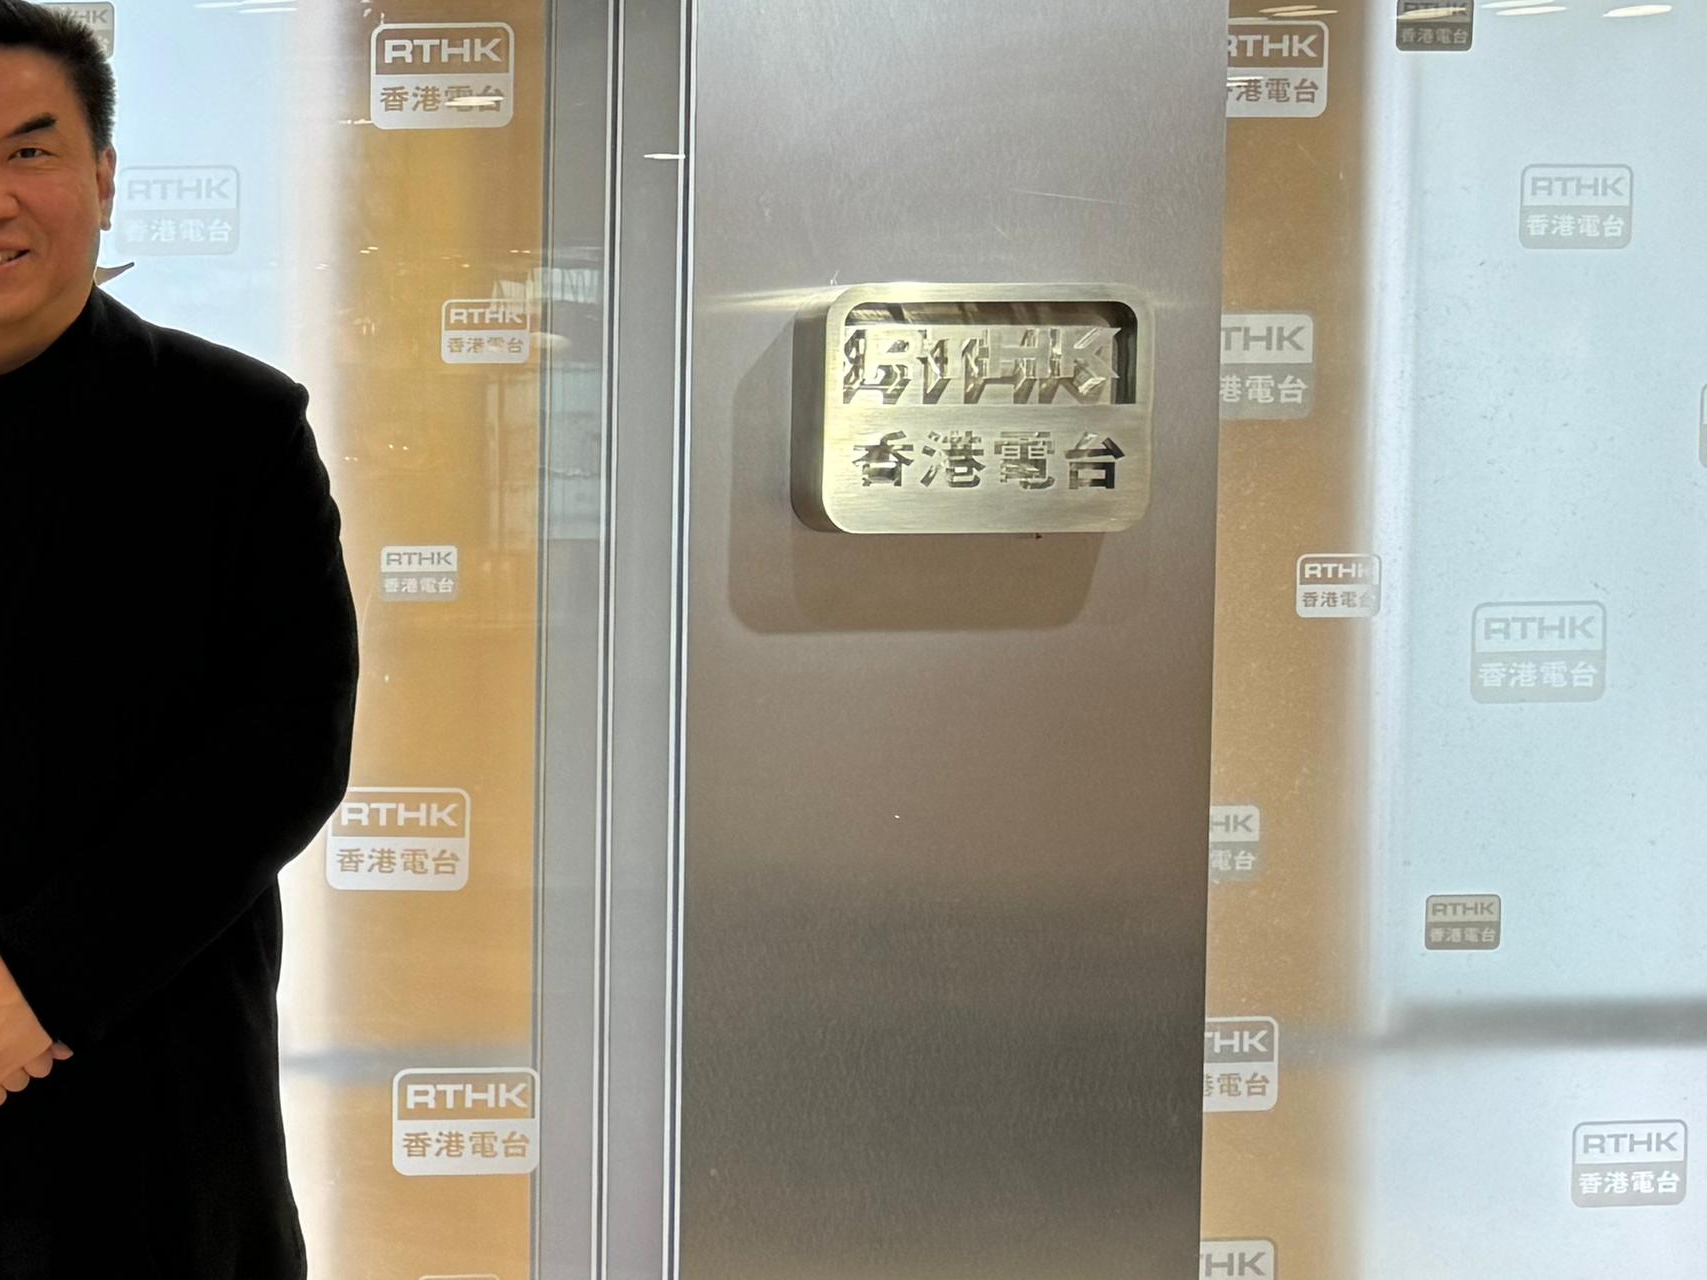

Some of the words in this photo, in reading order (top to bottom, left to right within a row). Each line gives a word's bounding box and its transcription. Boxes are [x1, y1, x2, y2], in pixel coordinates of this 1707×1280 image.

[384, 38, 503, 64] RTHK
[1227, 78, 1319, 104] 港電台
[127, 178, 231, 201] RTHK
[1530, 176, 1625, 197] RTHK
[1527, 214, 1625, 237] 香港電台
[449, 308, 523, 324] RTHK
[859, 326, 1123, 388] RTHK
[852, 430, 1125, 490] 香港電台
[386, 551, 453, 566] RTHK
[1483, 616, 1596, 640] RTHK
[1479, 661, 1597, 688] 香港電台
[340, 802, 459, 827] RTHK
[337, 848, 460, 875] 香港電台
[1431, 902, 1495, 916] RTHK
[406, 1083, 529, 1110] RTHK
[402, 1131, 530, 1159] 香港電台
[1582, 1131, 1678, 1154] RTHK
[1578, 1170, 1680, 1195] 香港電台
